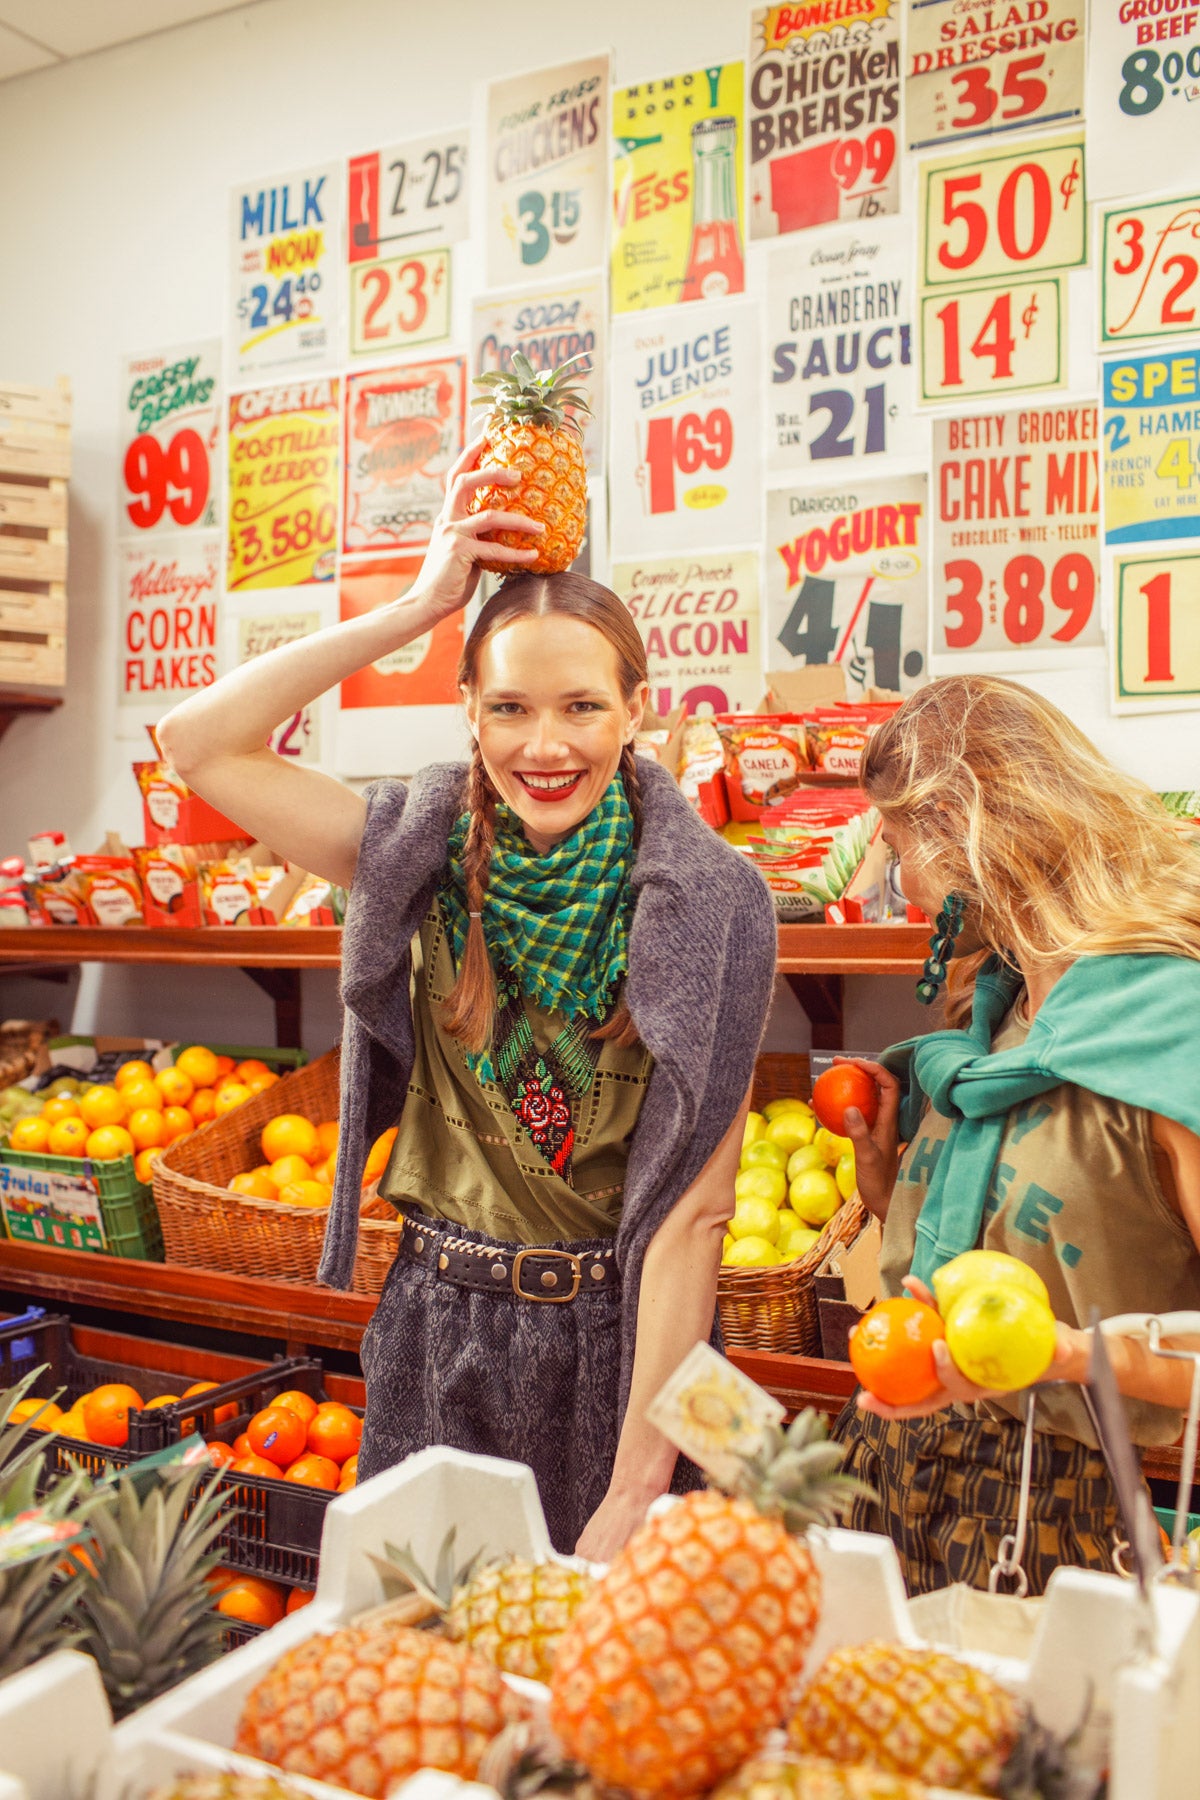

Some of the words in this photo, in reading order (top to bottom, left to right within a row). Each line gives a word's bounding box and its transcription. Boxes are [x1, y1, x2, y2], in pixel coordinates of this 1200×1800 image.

[774, 0, 876, 41] BONELESS
[941, 1, 1049, 42] SALAD
[1136, 11, 1199, 45] BEEF
[911, 18, 1078, 76] DRESSING
[627, 74, 694, 99] MEMO
[627, 94, 694, 120] BOOK
[495, 96, 599, 182] CHICKENS
[751, 83, 899, 165] BREASTS
[240, 175, 327, 241] MILK
[938, 158, 1079, 270] 50¢
[267, 232, 320, 273] NOW
[1113, 217, 1145, 276] 3
[513, 299, 582, 331] SODA
[790, 280, 902, 332] CRANBERRY
[636, 324, 731, 388] JUICE
[936, 291, 1038, 387] 14¢
[129, 357, 202, 411] GREEN
[640, 356, 733, 410] BLENDS
[1111, 357, 1200, 402] SPE
[137, 377, 215, 433] BEANS
[239, 382, 334, 420] OFERTA
[950, 416, 1006, 451] BETTY
[1104, 414, 1130, 452] 2
[260, 456, 329, 485] CERDO
[1105, 456, 1152, 473] FRENCH
[1110, 473, 1145, 488] FRIES
[939, 456, 1032, 522] CAKE
[778, 503, 922, 591] YOGURT
[952, 528, 1008, 546] CHOCOLATE
[1019, 526, 1047, 542] WHITE
[1058, 524, 1098, 540] YELLOW
[628, 588, 738, 619] SLICED
[944, 559, 984, 649] 3
[126, 603, 217, 654] CORN
[645, 620, 748, 658] ACON
[125, 653, 217, 693] FLAKES
[743, 757, 790, 771] CANELA
[829, 757, 860, 769] CANE
[774, 896, 813, 907] OURO
[0, 1166, 50, 1196] Frutas
